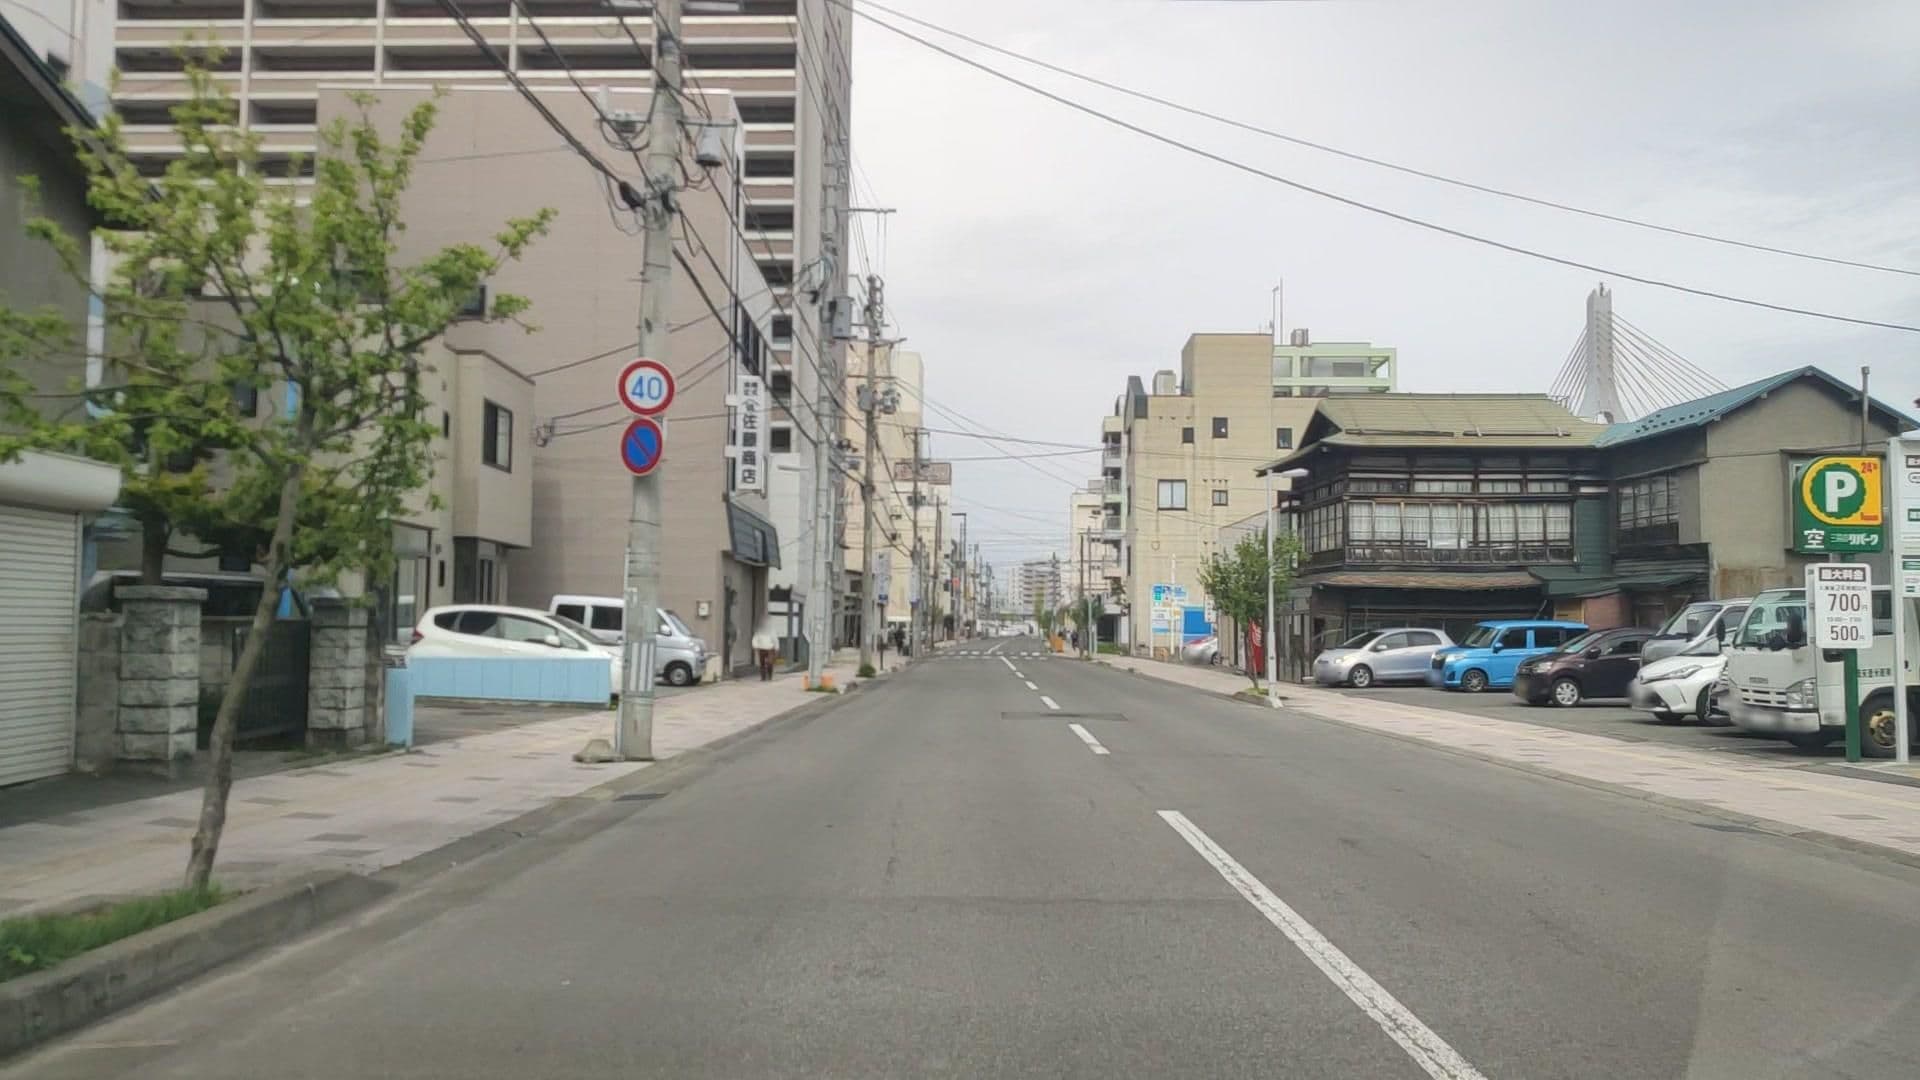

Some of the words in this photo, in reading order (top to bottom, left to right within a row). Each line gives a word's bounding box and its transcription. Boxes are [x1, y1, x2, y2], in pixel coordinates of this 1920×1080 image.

[631, 375, 663, 400] 40
[1825, 471, 1858, 512] P
[1803, 528, 1825, 549] 空
